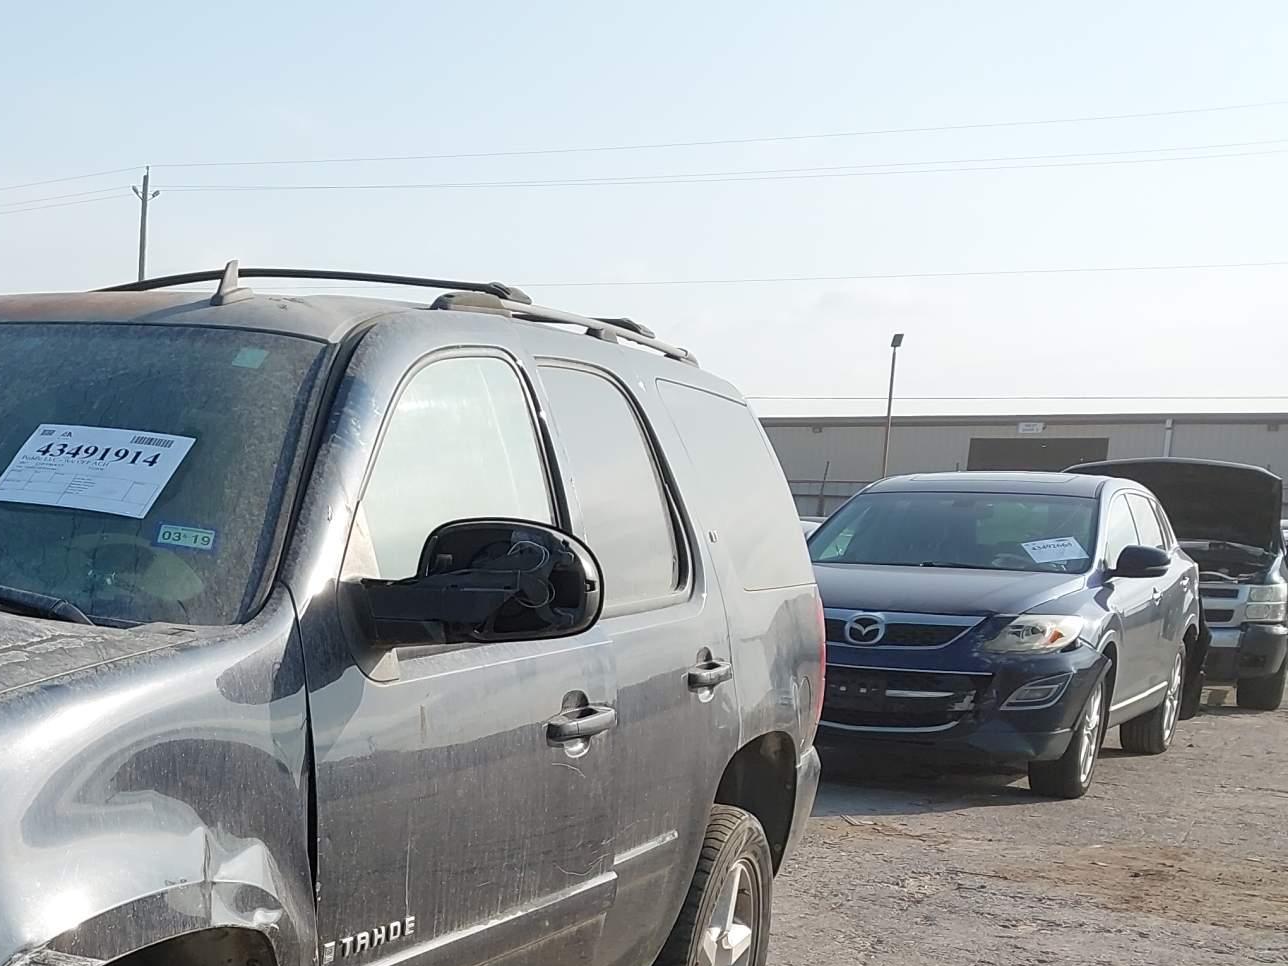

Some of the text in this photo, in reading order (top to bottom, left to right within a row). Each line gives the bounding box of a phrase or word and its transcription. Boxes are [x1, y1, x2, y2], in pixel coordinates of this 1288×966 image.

[36, 442, 161, 467] 43491914
[162, 530, 211, 546] 03 19
[341, 916, 415, 958] TAHOE
